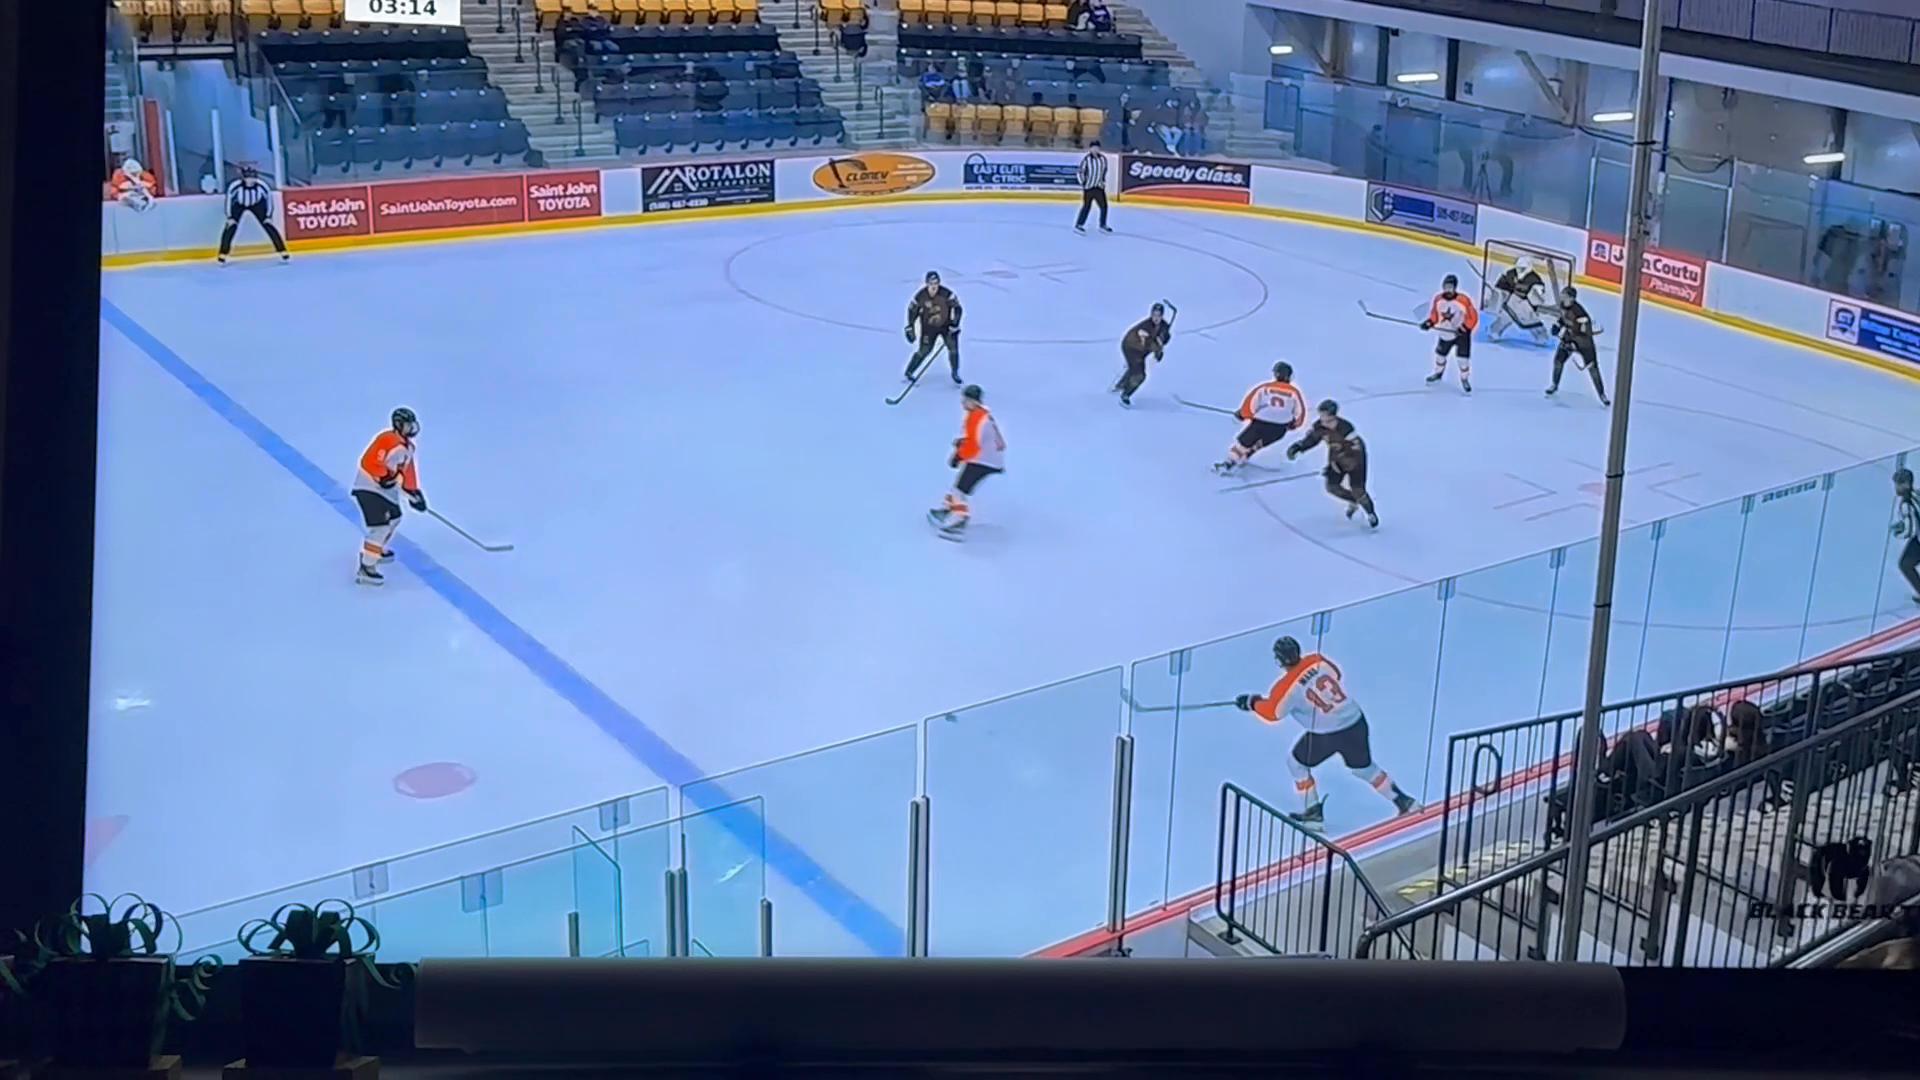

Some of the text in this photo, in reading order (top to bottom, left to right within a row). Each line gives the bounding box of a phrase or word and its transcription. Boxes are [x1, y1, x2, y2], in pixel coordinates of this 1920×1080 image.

[368, 0, 438, 16] 03:14
[683, 162, 771, 181] ROTALON
[528, 181, 598, 199] Saint John
[286, 197, 366, 216] Saint John
[379, 195, 518, 216] SaintJohnToyota.com
[536, 195, 592, 213] TOYOTA
[297, 213, 358, 230] TOYOTA
[1652, 257, 1699, 283] Coutu
[1306, 673, 1347, 714] 13
